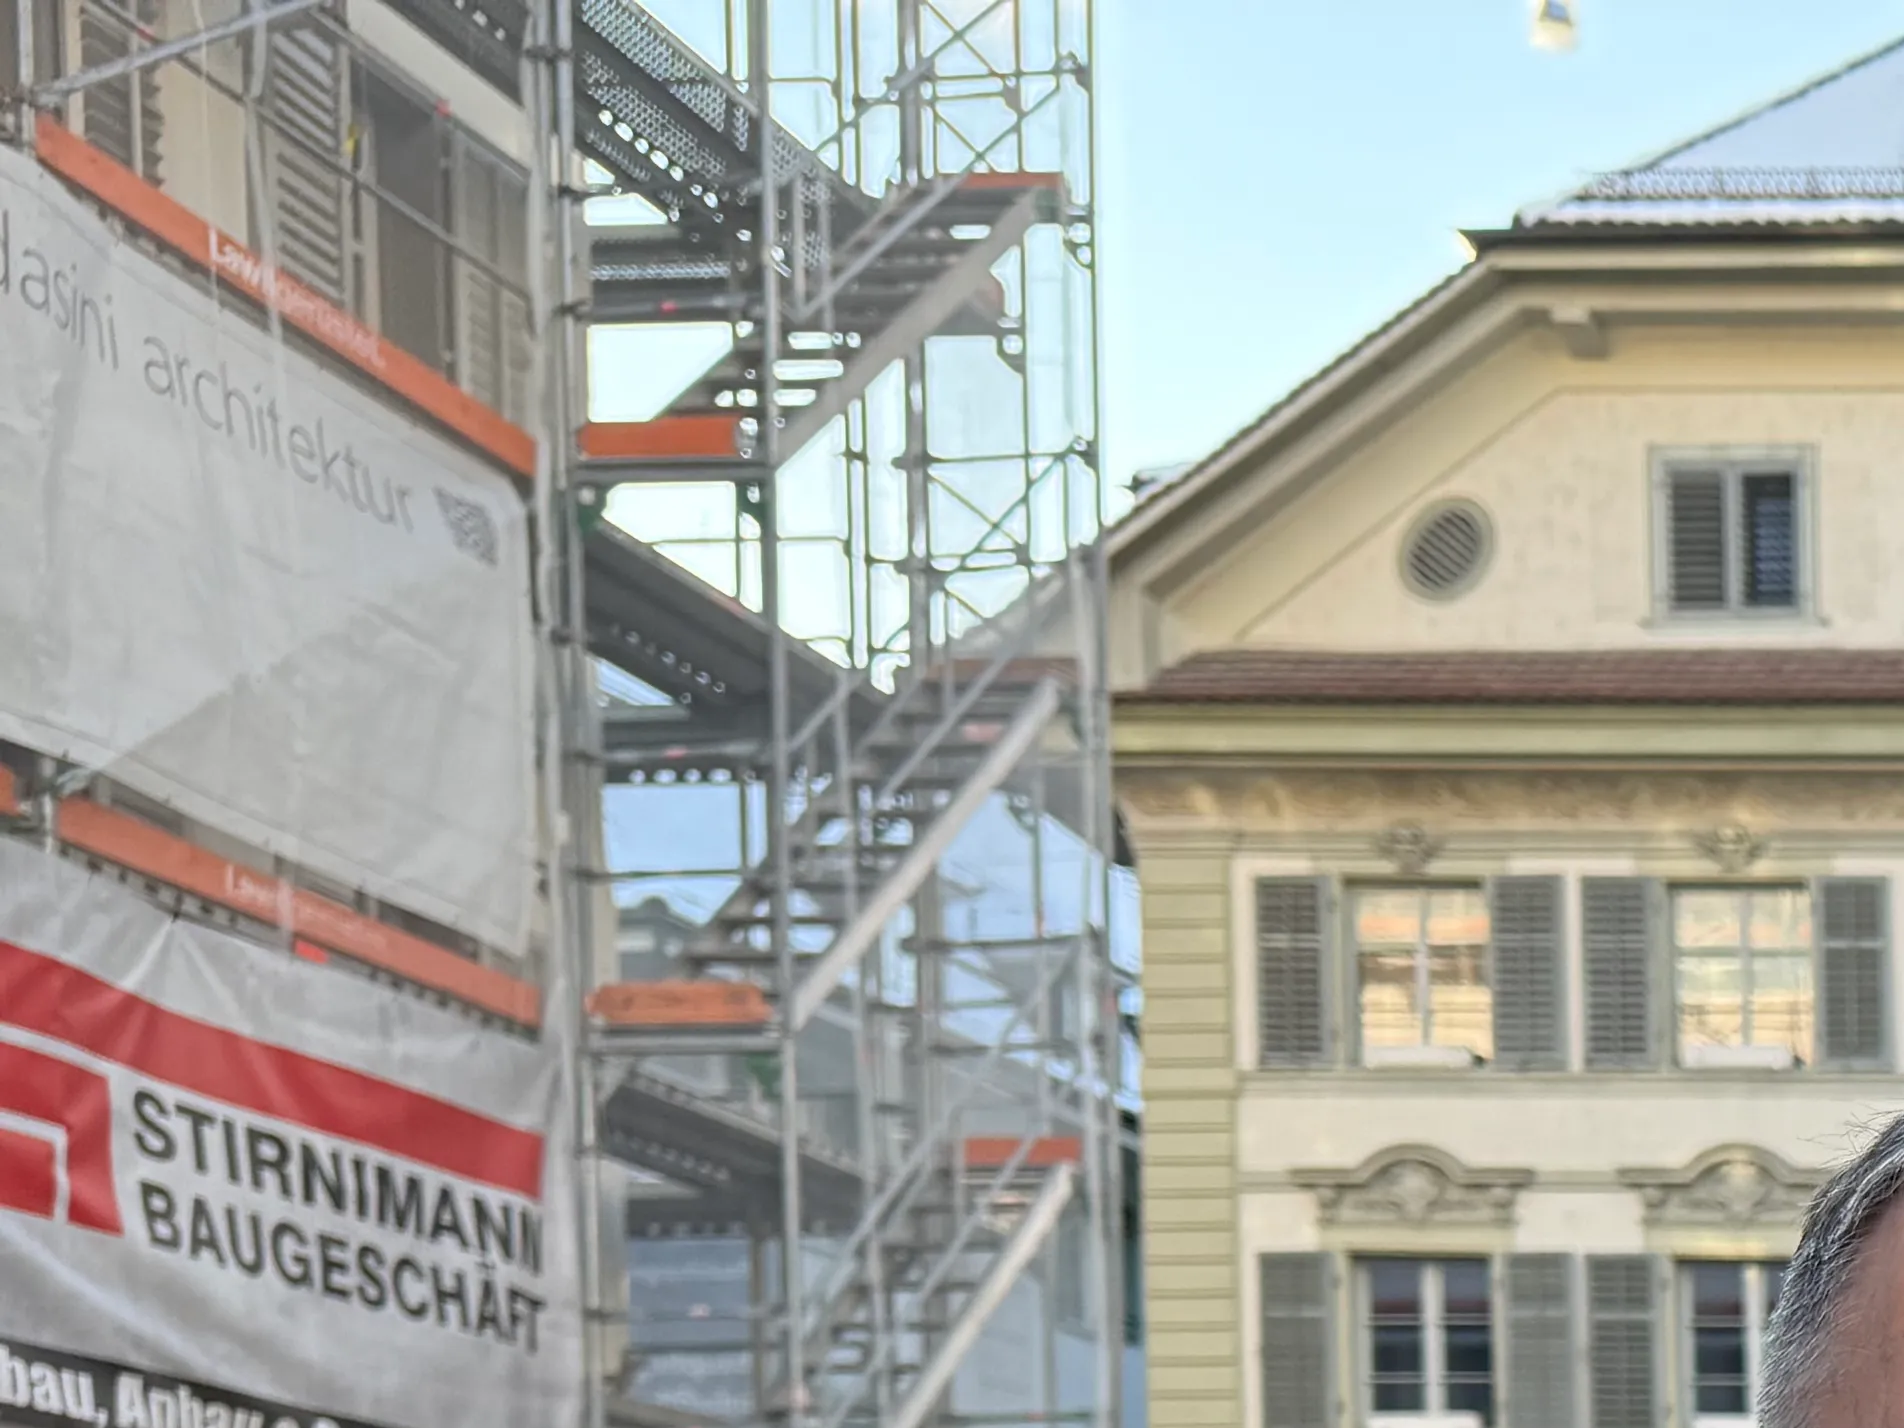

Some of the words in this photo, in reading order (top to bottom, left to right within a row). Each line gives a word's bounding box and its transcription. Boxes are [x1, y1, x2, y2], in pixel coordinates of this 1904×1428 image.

[144, 336, 414, 532] architektur
[132, 1088, 544, 1277] STIRNIMANN
[138, 1181, 546, 1355] BAUGESCHÄFT
